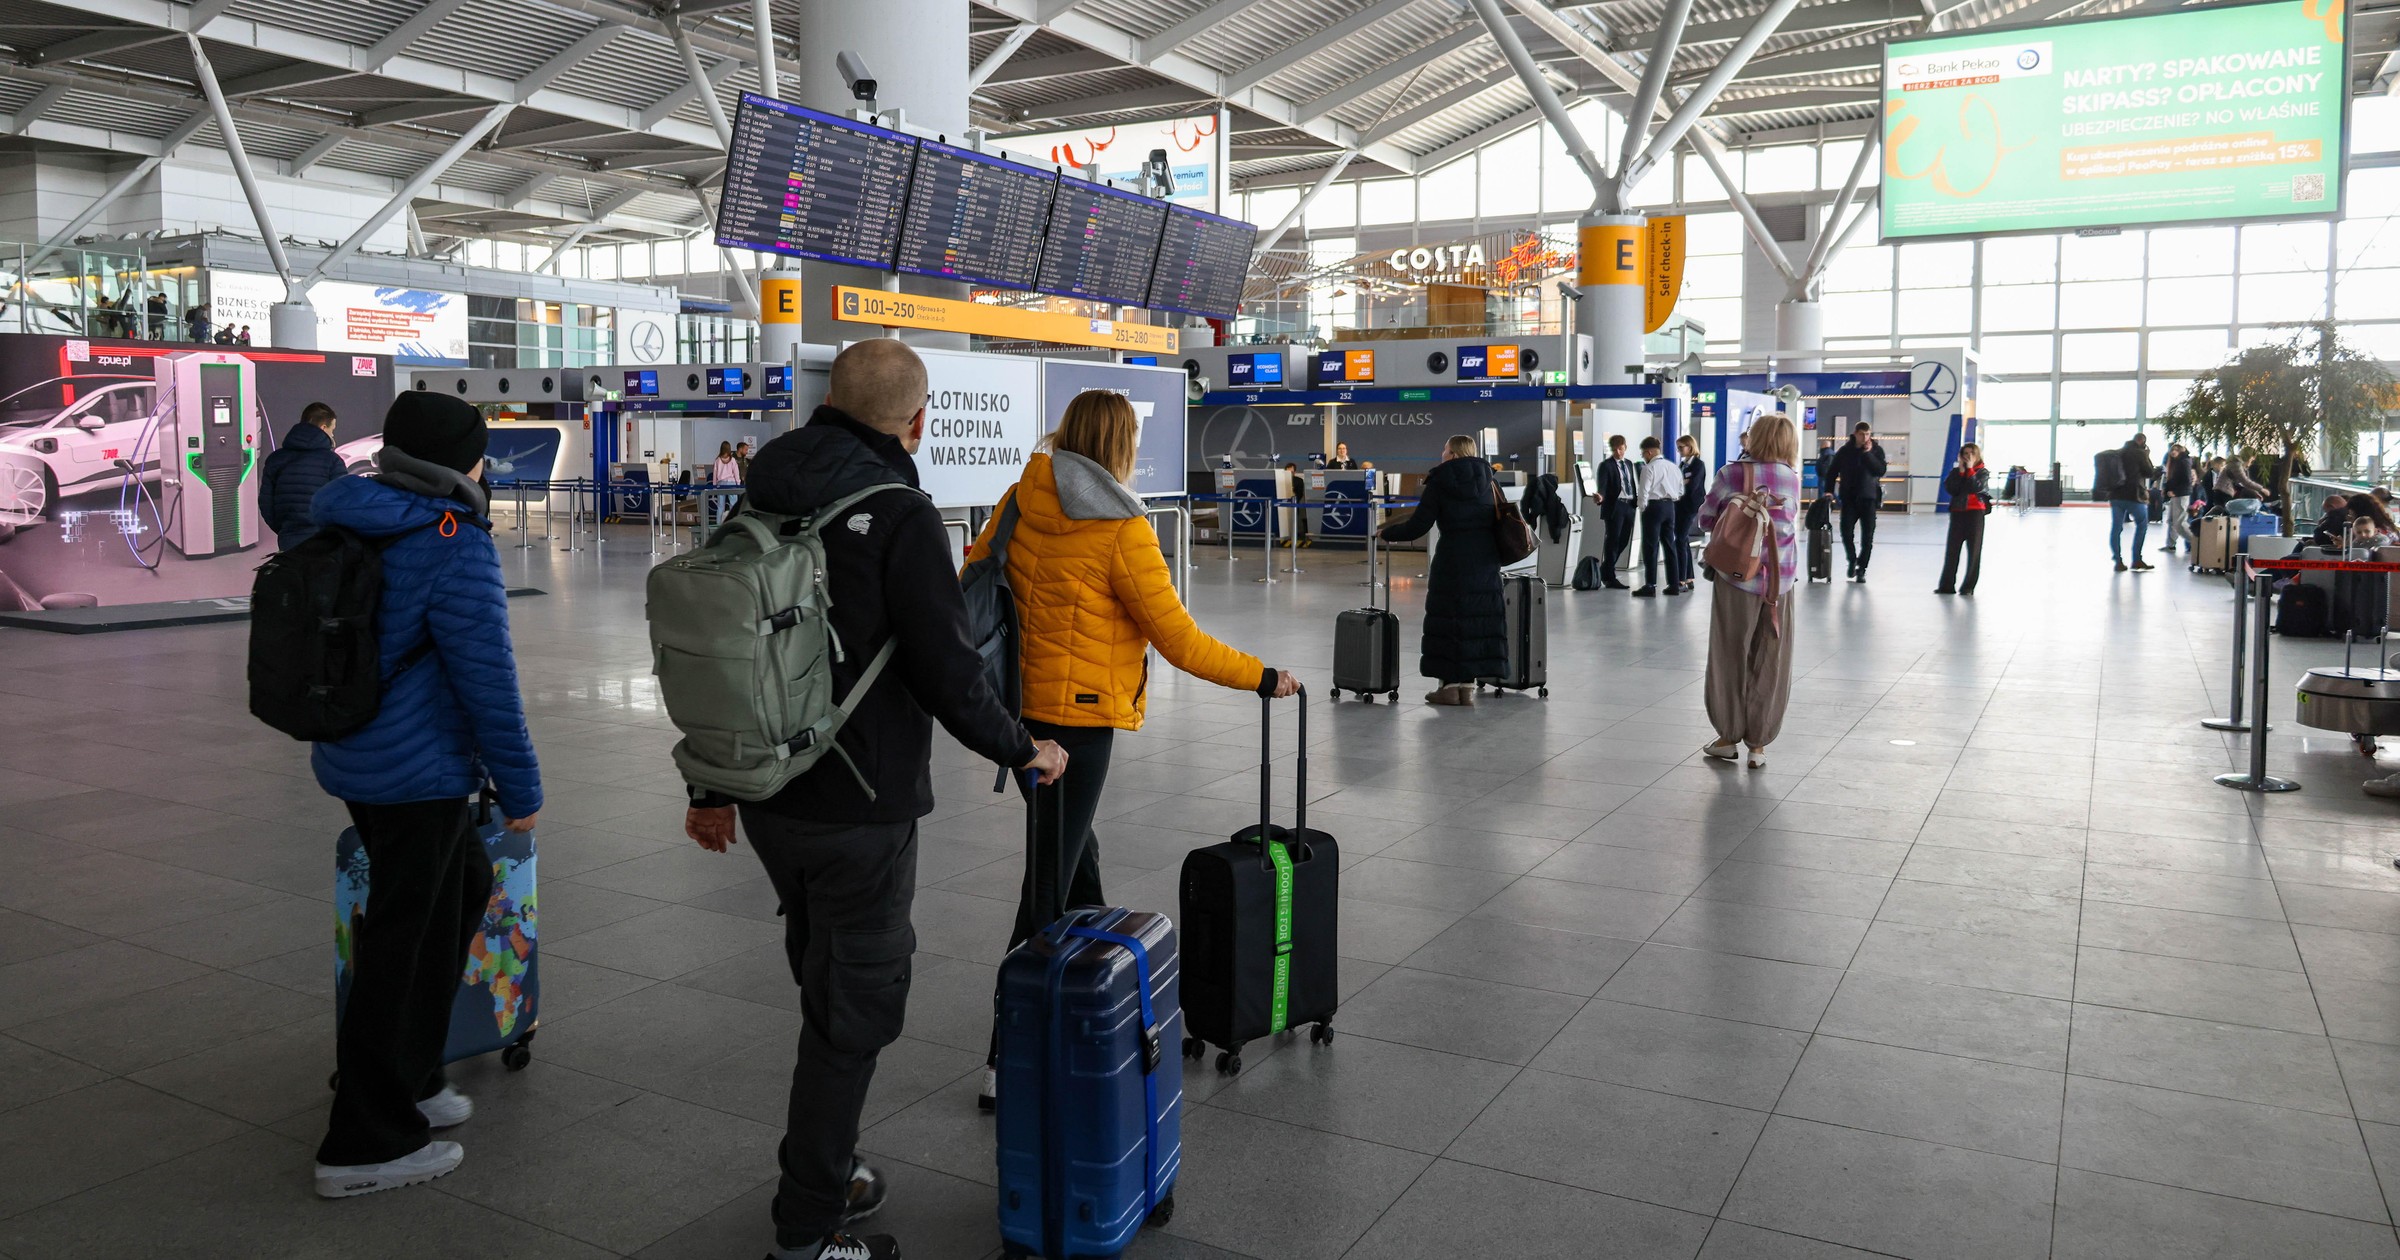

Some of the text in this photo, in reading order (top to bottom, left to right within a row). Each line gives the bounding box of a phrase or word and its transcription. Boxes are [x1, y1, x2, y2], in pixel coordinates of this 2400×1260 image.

[1928, 59, 1999, 74] Bank Pekao
[2063, 46, 2321, 88] NARTY? SPAKOWANE
[1975, 76, 1997, 84] ROGI
[2062, 72, 2324, 114] SKIPASS? OPŁACONY
[2062, 100, 2319, 136] UBEZPIECZENIE? NO WŁAŚNIE
[2067, 152, 2088, 163] Kup
[2090, 146, 2171, 161] ubezpieczenie
[2232, 138, 2268, 148] online
[2278, 144, 2314, 159] 15%.
[1175, 170, 1203, 180] remium
[1391, 244, 1486, 272] COSTA
[1616, 239, 1634, 270] E
[1660, 222, 1671, 296] Self check-in
[1415, 274, 1461, 283] COFFEE
[217, 297, 257, 308] BIZNES
[779, 289, 794, 312] E
[218, 309, 232, 317] NA
[98, 356, 131, 367] zpue.pl
[1232, 364, 1251, 374] LOT
[1323, 362, 1342, 371] LOT
[1462, 358, 1483, 367] LOT
[769, 376, 781, 384] LOT
[1841, 381, 1860, 389] LOT
[931, 390, 1010, 412] LOTNISKO
[1287, 413, 1433, 425] LOT EONOMY CLASS
[931, 418, 1003, 438] CHOPINA
[931, 447, 1022, 465] WARSZAWA
[1280, 866, 1290, 915] LOOKING
[1279, 918, 1287, 940] FOR
[1276, 958, 1286, 999] OWNER
